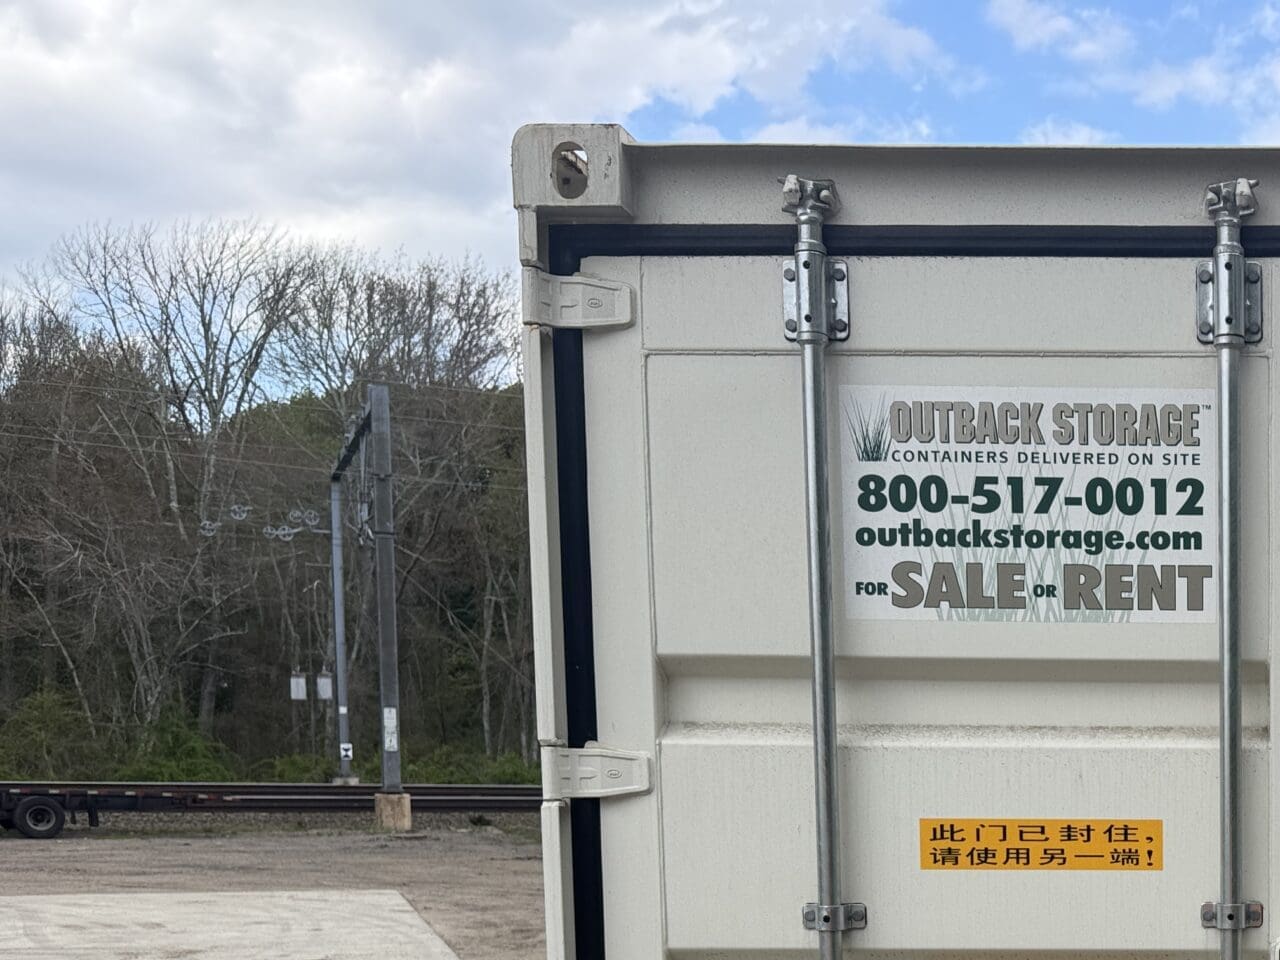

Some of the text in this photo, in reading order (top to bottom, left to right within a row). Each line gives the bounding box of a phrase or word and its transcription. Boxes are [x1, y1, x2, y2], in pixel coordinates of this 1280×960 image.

[889, 400, 1046, 444] OUTBACK
[1052, 402, 1201, 447] STORAGE
[891, 450, 1201, 466] CONTAINERS DELIVERED ON SITE
[857, 474, 1205, 516] 800-517-0012
[855, 519, 1202, 555] outbackstorage.com
[855, 561, 1212, 611] FOR SALE OR RENT
[929, 824, 1155, 844] 此门已封住，
[929, 847, 1154, 866] 请使用另一端！
